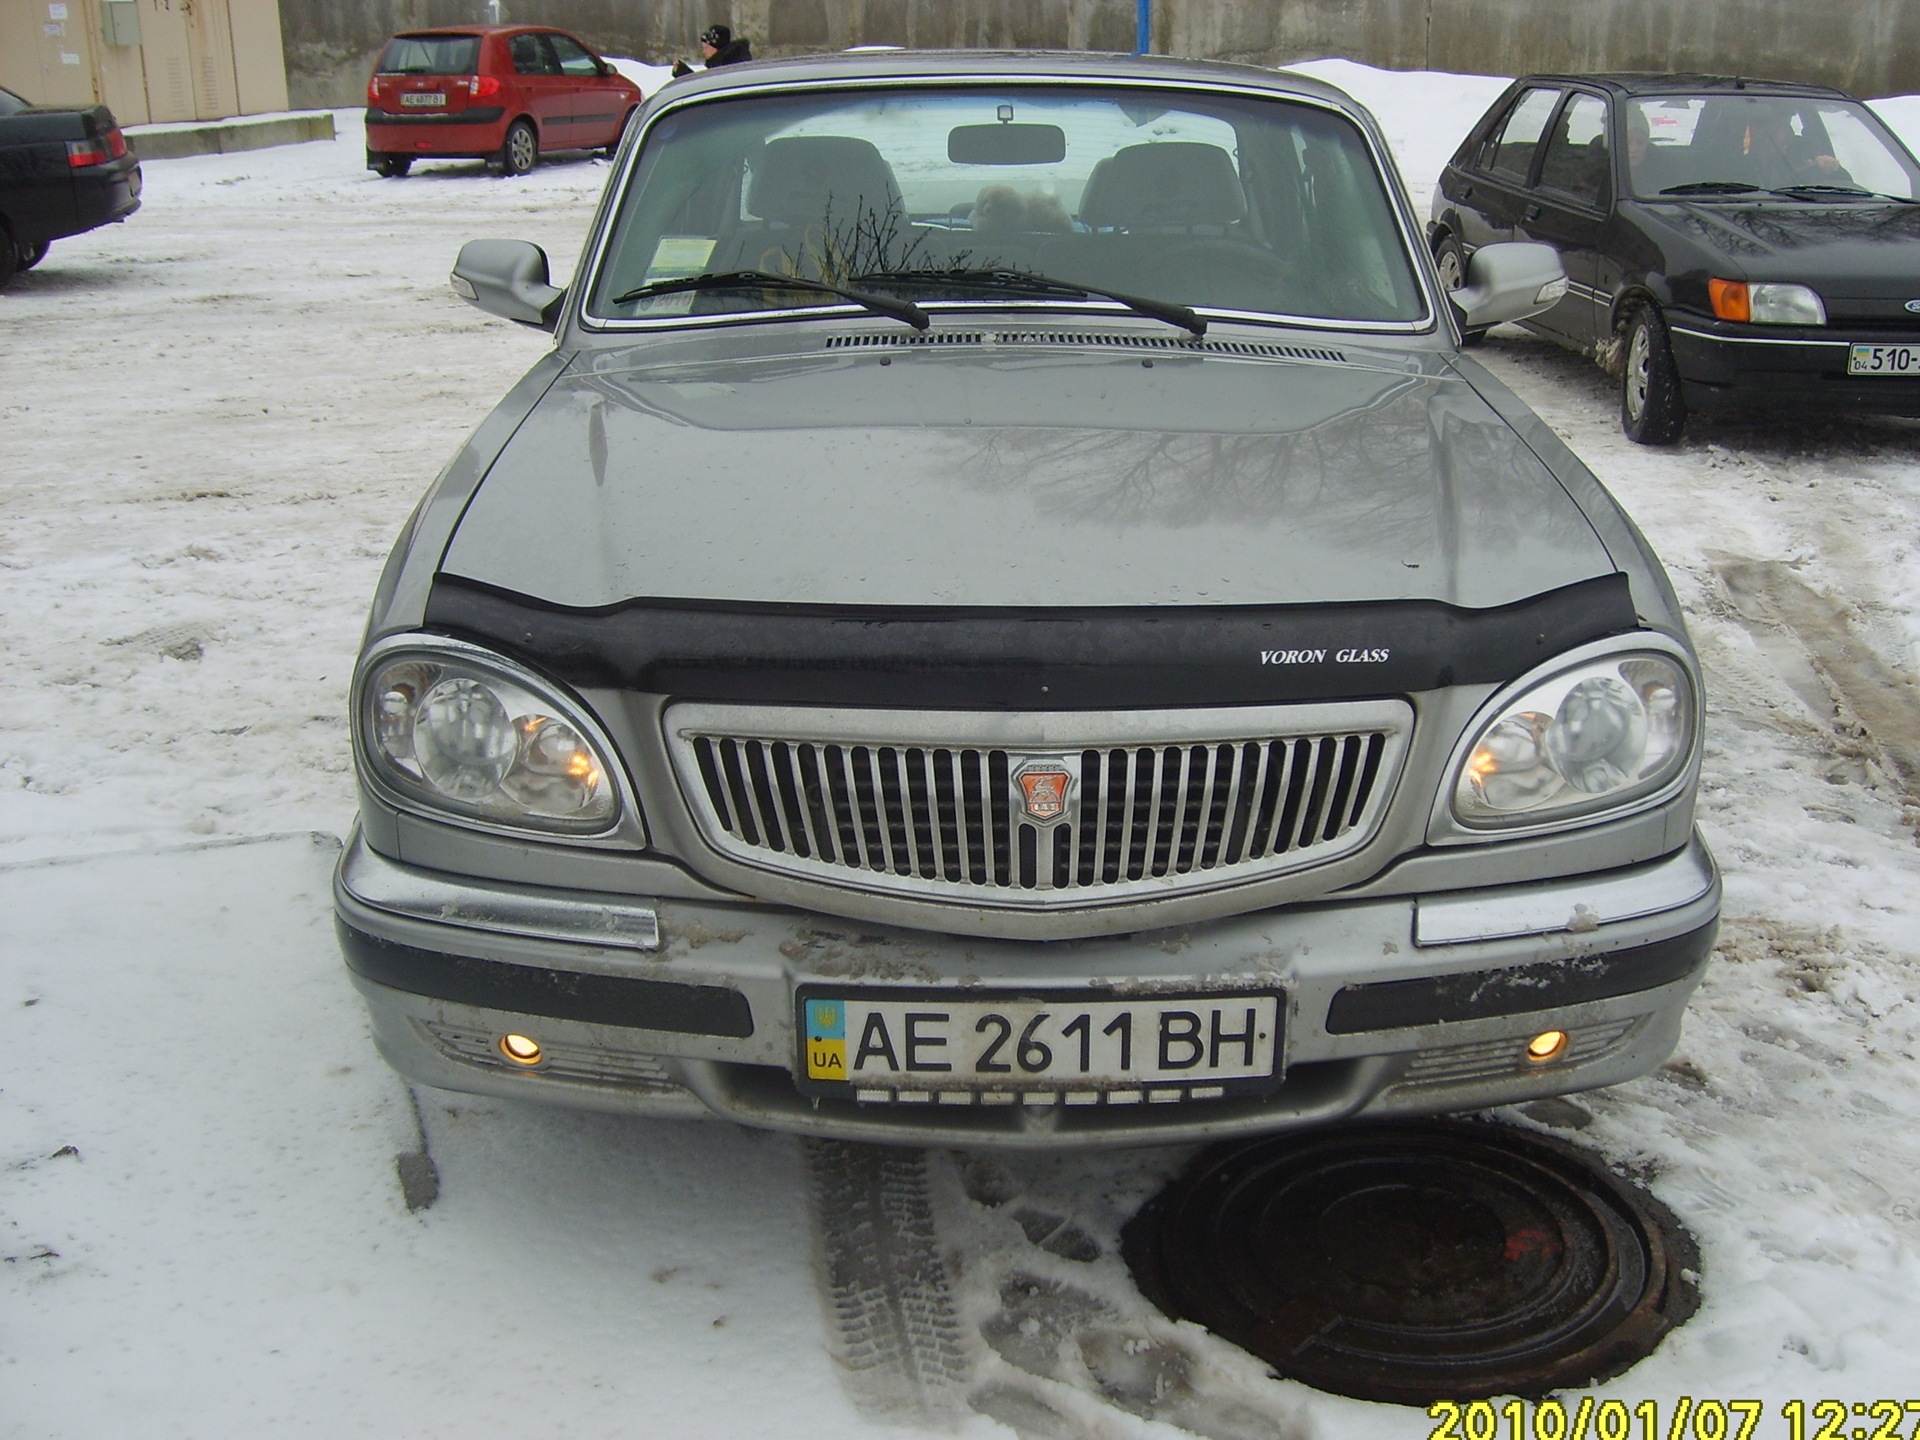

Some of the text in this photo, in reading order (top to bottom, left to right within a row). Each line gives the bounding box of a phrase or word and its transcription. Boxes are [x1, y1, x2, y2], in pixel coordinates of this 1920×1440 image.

[1854, 360, 1868, 370] 04
[1870, 348, 1920, 371] 510-
[1260, 649, 1390, 665] VORON GLASS
[853, 1008, 1256, 1073] AE 2611 BH
[813, 1052, 842, 1068] UA
